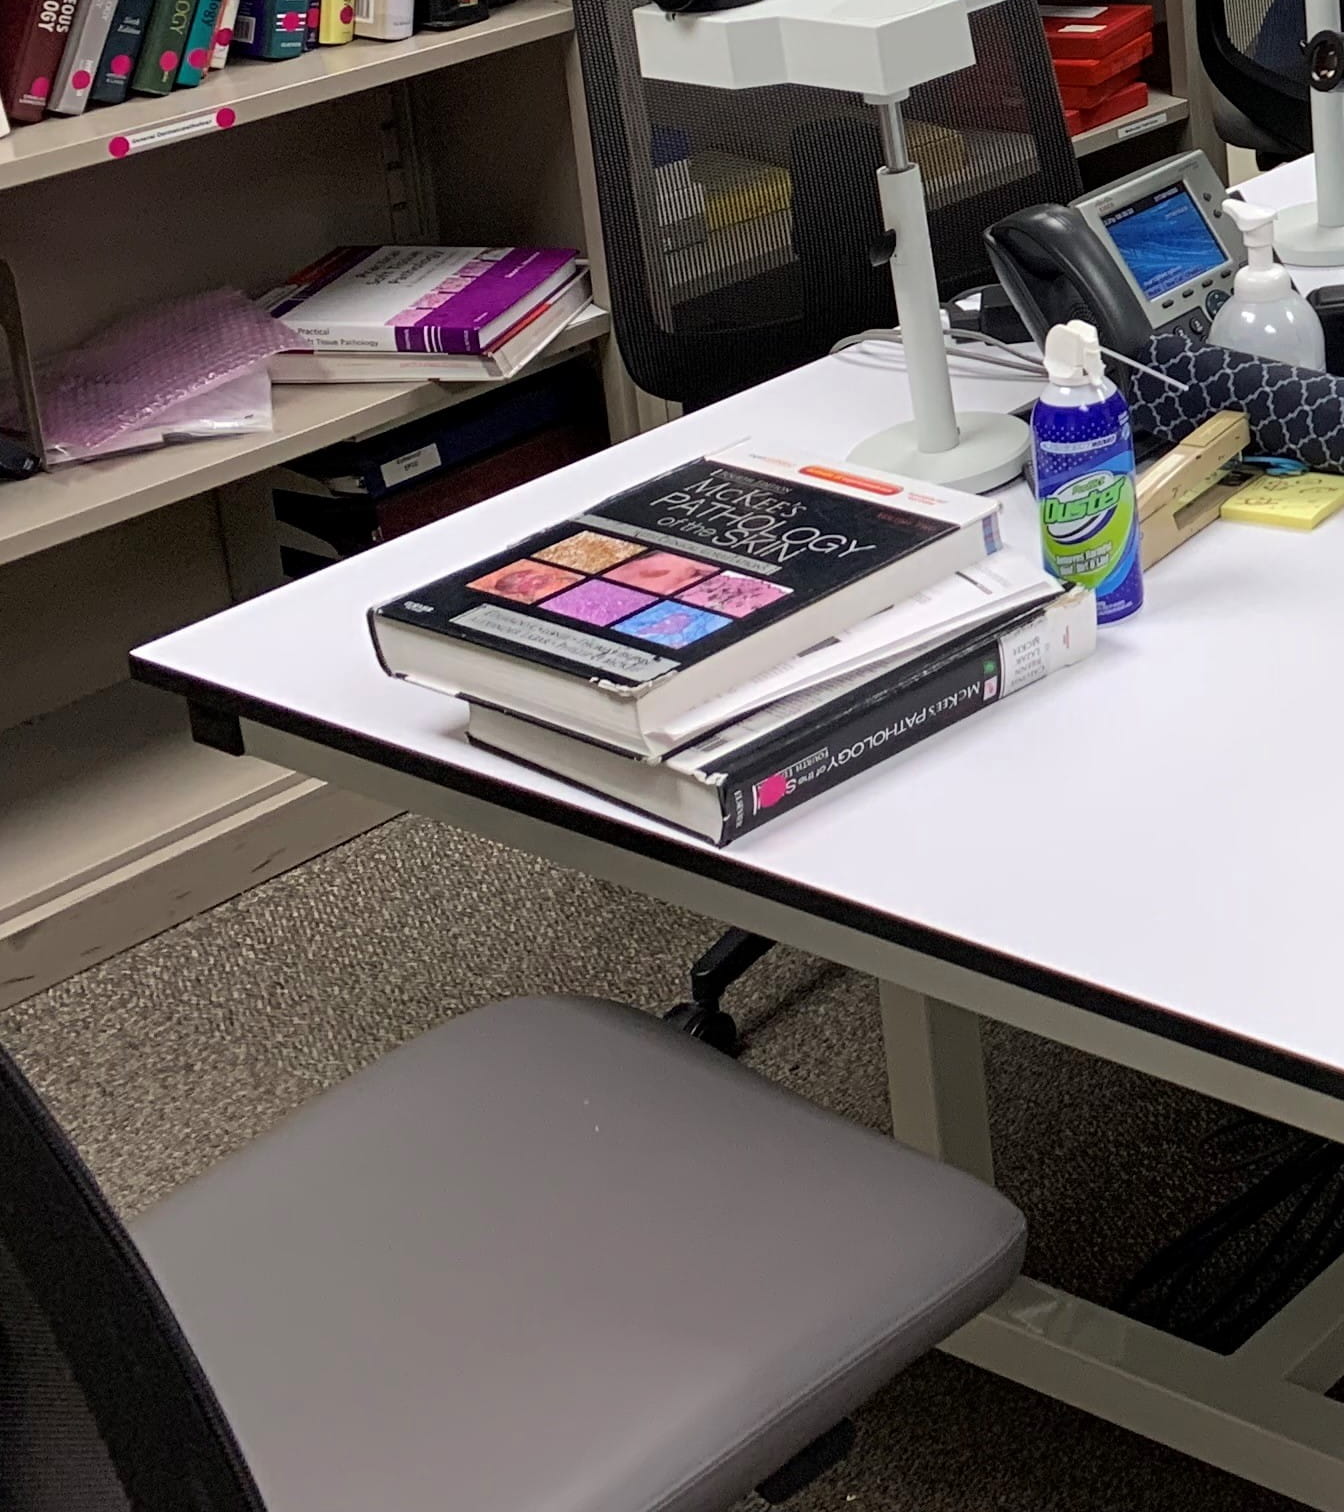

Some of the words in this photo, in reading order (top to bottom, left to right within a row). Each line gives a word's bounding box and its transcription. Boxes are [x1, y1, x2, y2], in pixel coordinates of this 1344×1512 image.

[298, 327, 330, 336] Practical
[650, 492, 877, 557] PATHOLOGY
[657, 515, 678, 528] of
[679, 516, 717, 538] the
[711, 528, 800, 563] SKIN
[825, 709, 928, 772] PATHOLOGY
[798, 770, 816, 786] the
